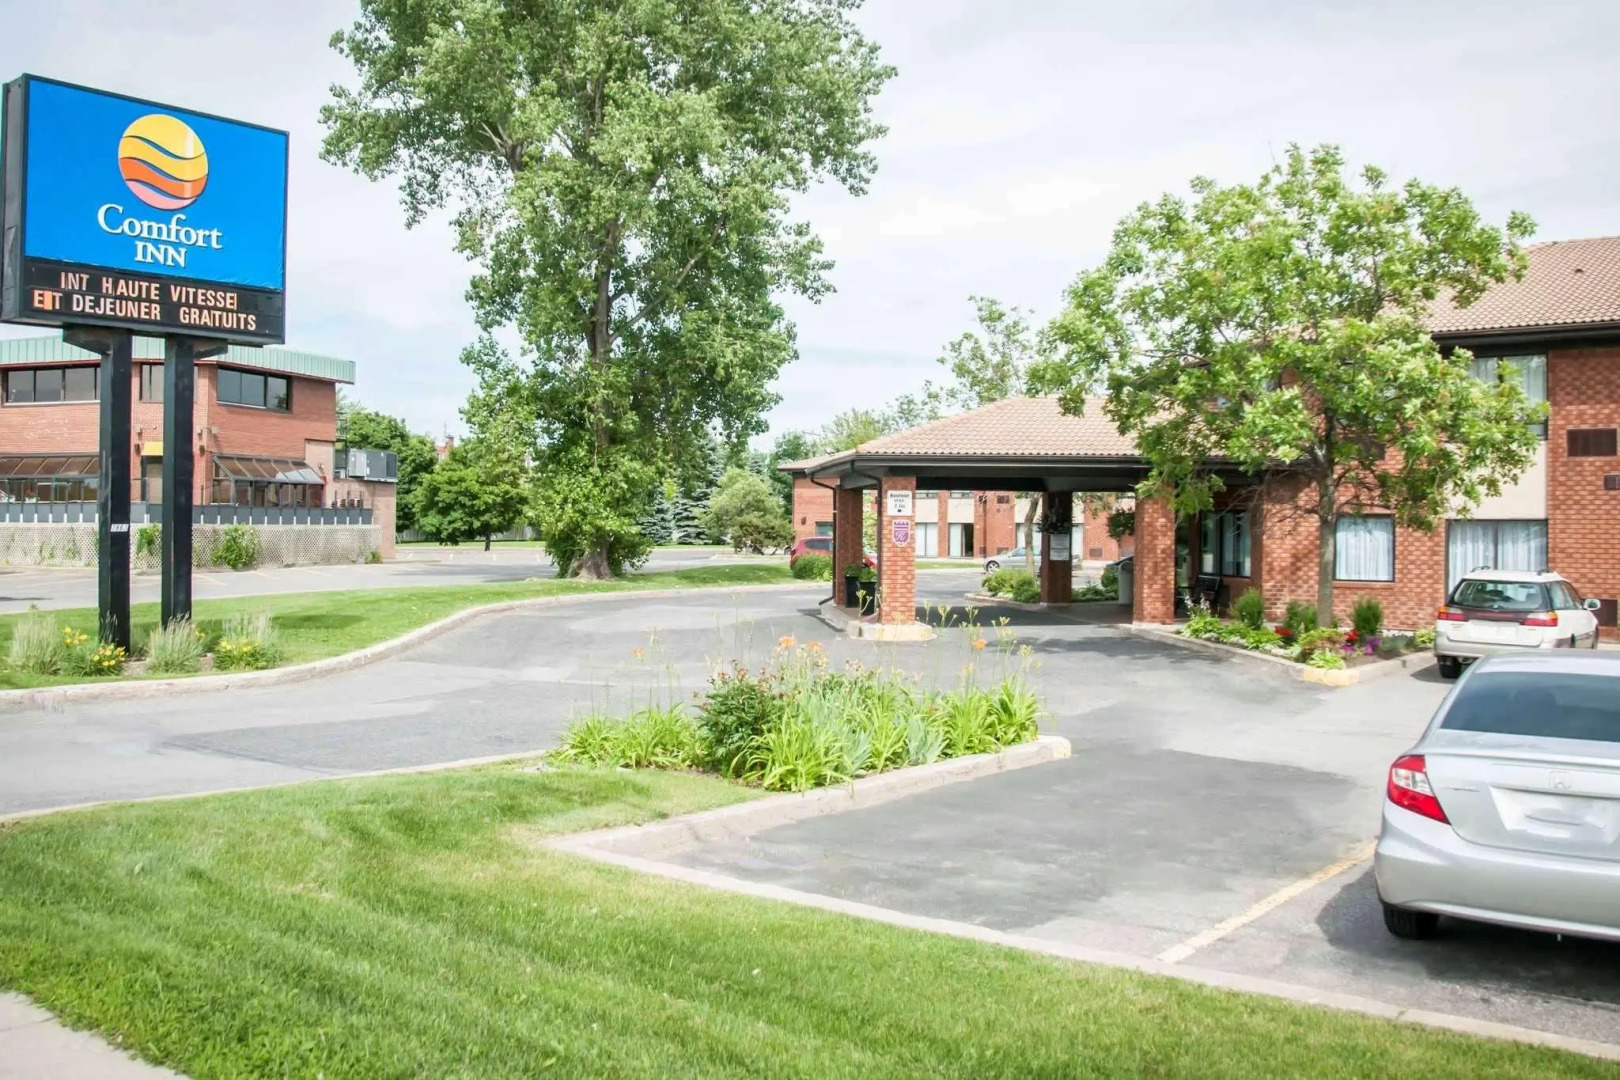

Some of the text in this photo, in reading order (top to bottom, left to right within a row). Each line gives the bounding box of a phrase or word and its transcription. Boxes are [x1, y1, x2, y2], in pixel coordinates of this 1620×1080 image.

[97, 203, 223, 249] Comfort
[134, 240, 187, 268] INN
[60, 272, 237, 310] INT HAUTE VITESSE
[72, 294, 160, 320] DEJEUNER
[179, 307, 256, 331] GRATUITS
